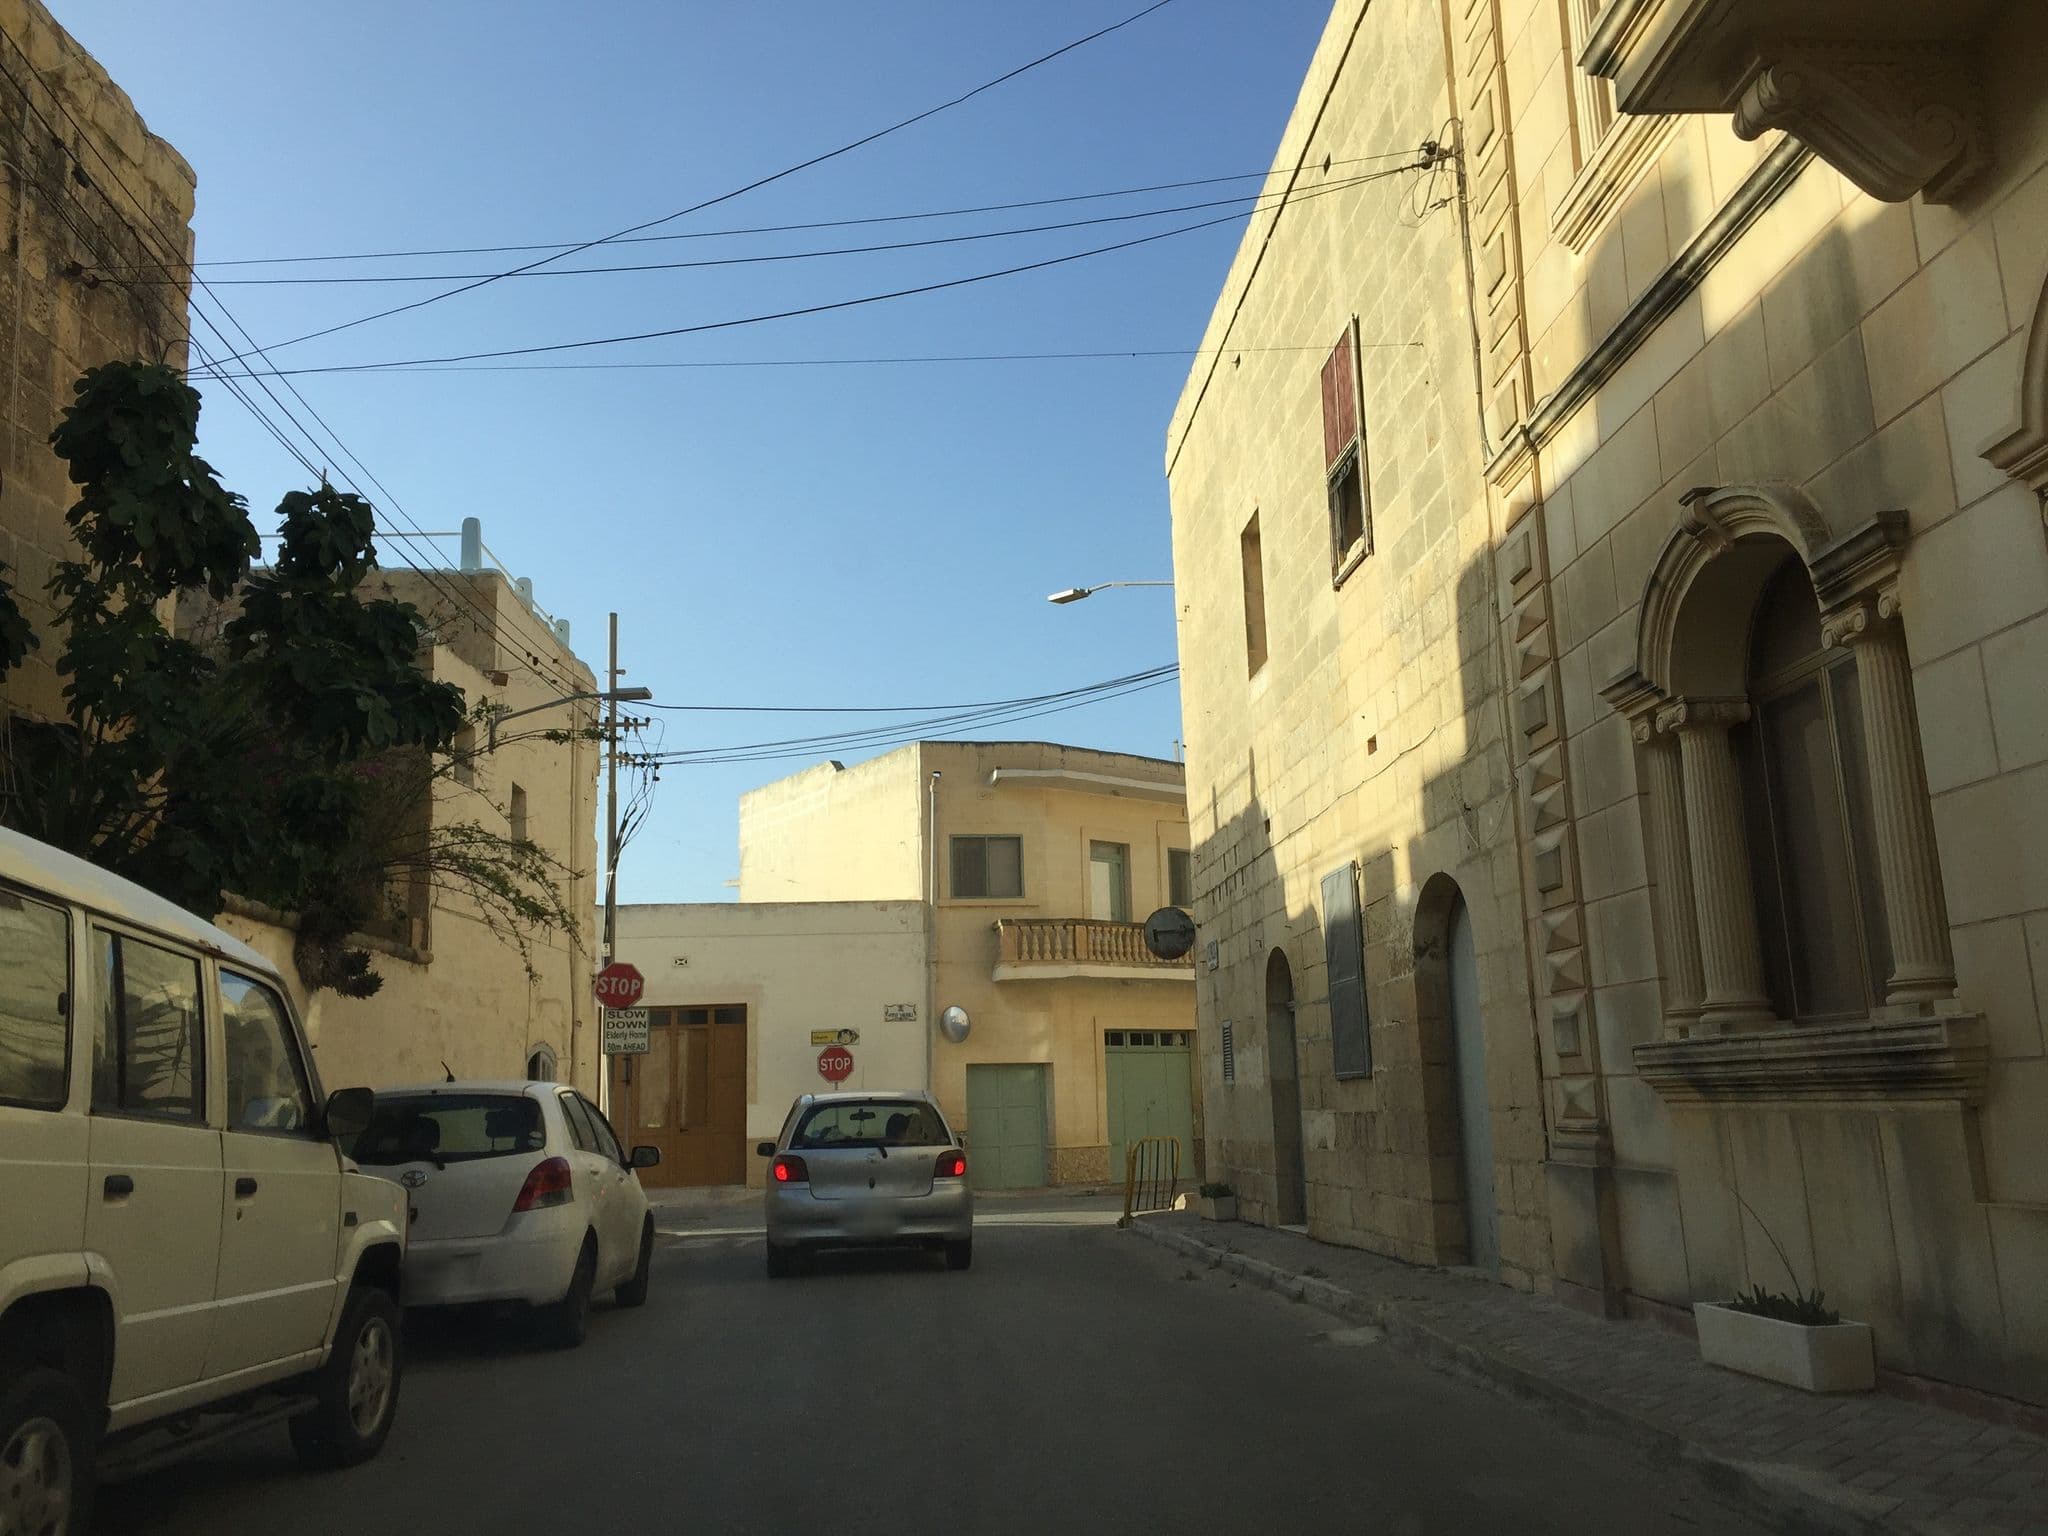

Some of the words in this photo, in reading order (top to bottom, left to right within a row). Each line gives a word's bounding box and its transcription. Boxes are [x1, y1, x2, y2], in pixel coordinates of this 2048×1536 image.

[598, 976, 641, 996] STOP
[607, 1010, 646, 1019] SLOW
[607, 1021, 646, 1029] DOWN
[606, 1031, 628, 1040] Elderly
[629, 1031, 646, 1039] Home
[623, 1042, 646, 1051] AHEAD
[820, 1057, 851, 1071] STOP
